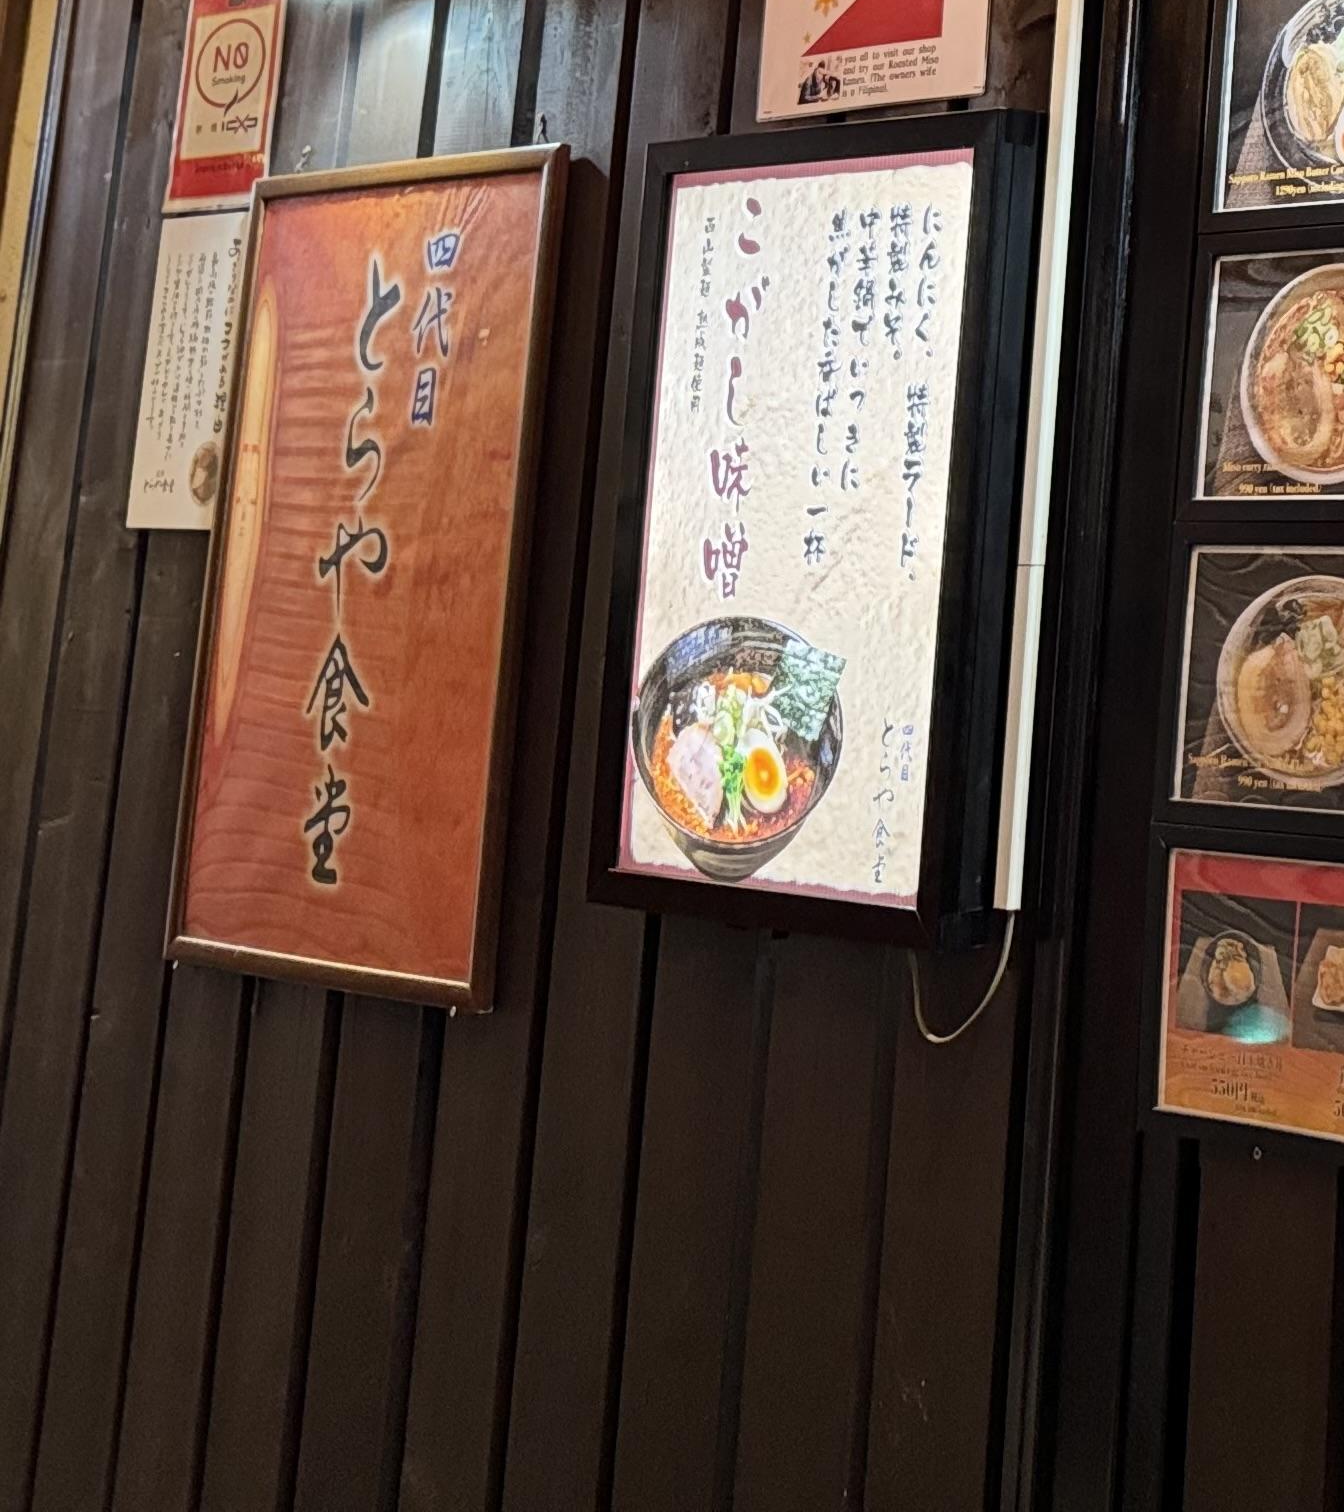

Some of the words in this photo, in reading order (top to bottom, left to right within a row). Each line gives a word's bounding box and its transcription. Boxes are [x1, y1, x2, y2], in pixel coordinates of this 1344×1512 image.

[213, 42, 250, 73] NO
[411, 230, 461, 428] 四代目
[704, 197, 771, 599] こがし味噌
[302, 257, 403, 885] とらや食堂
[872, 717, 895, 884] とらや食堂
